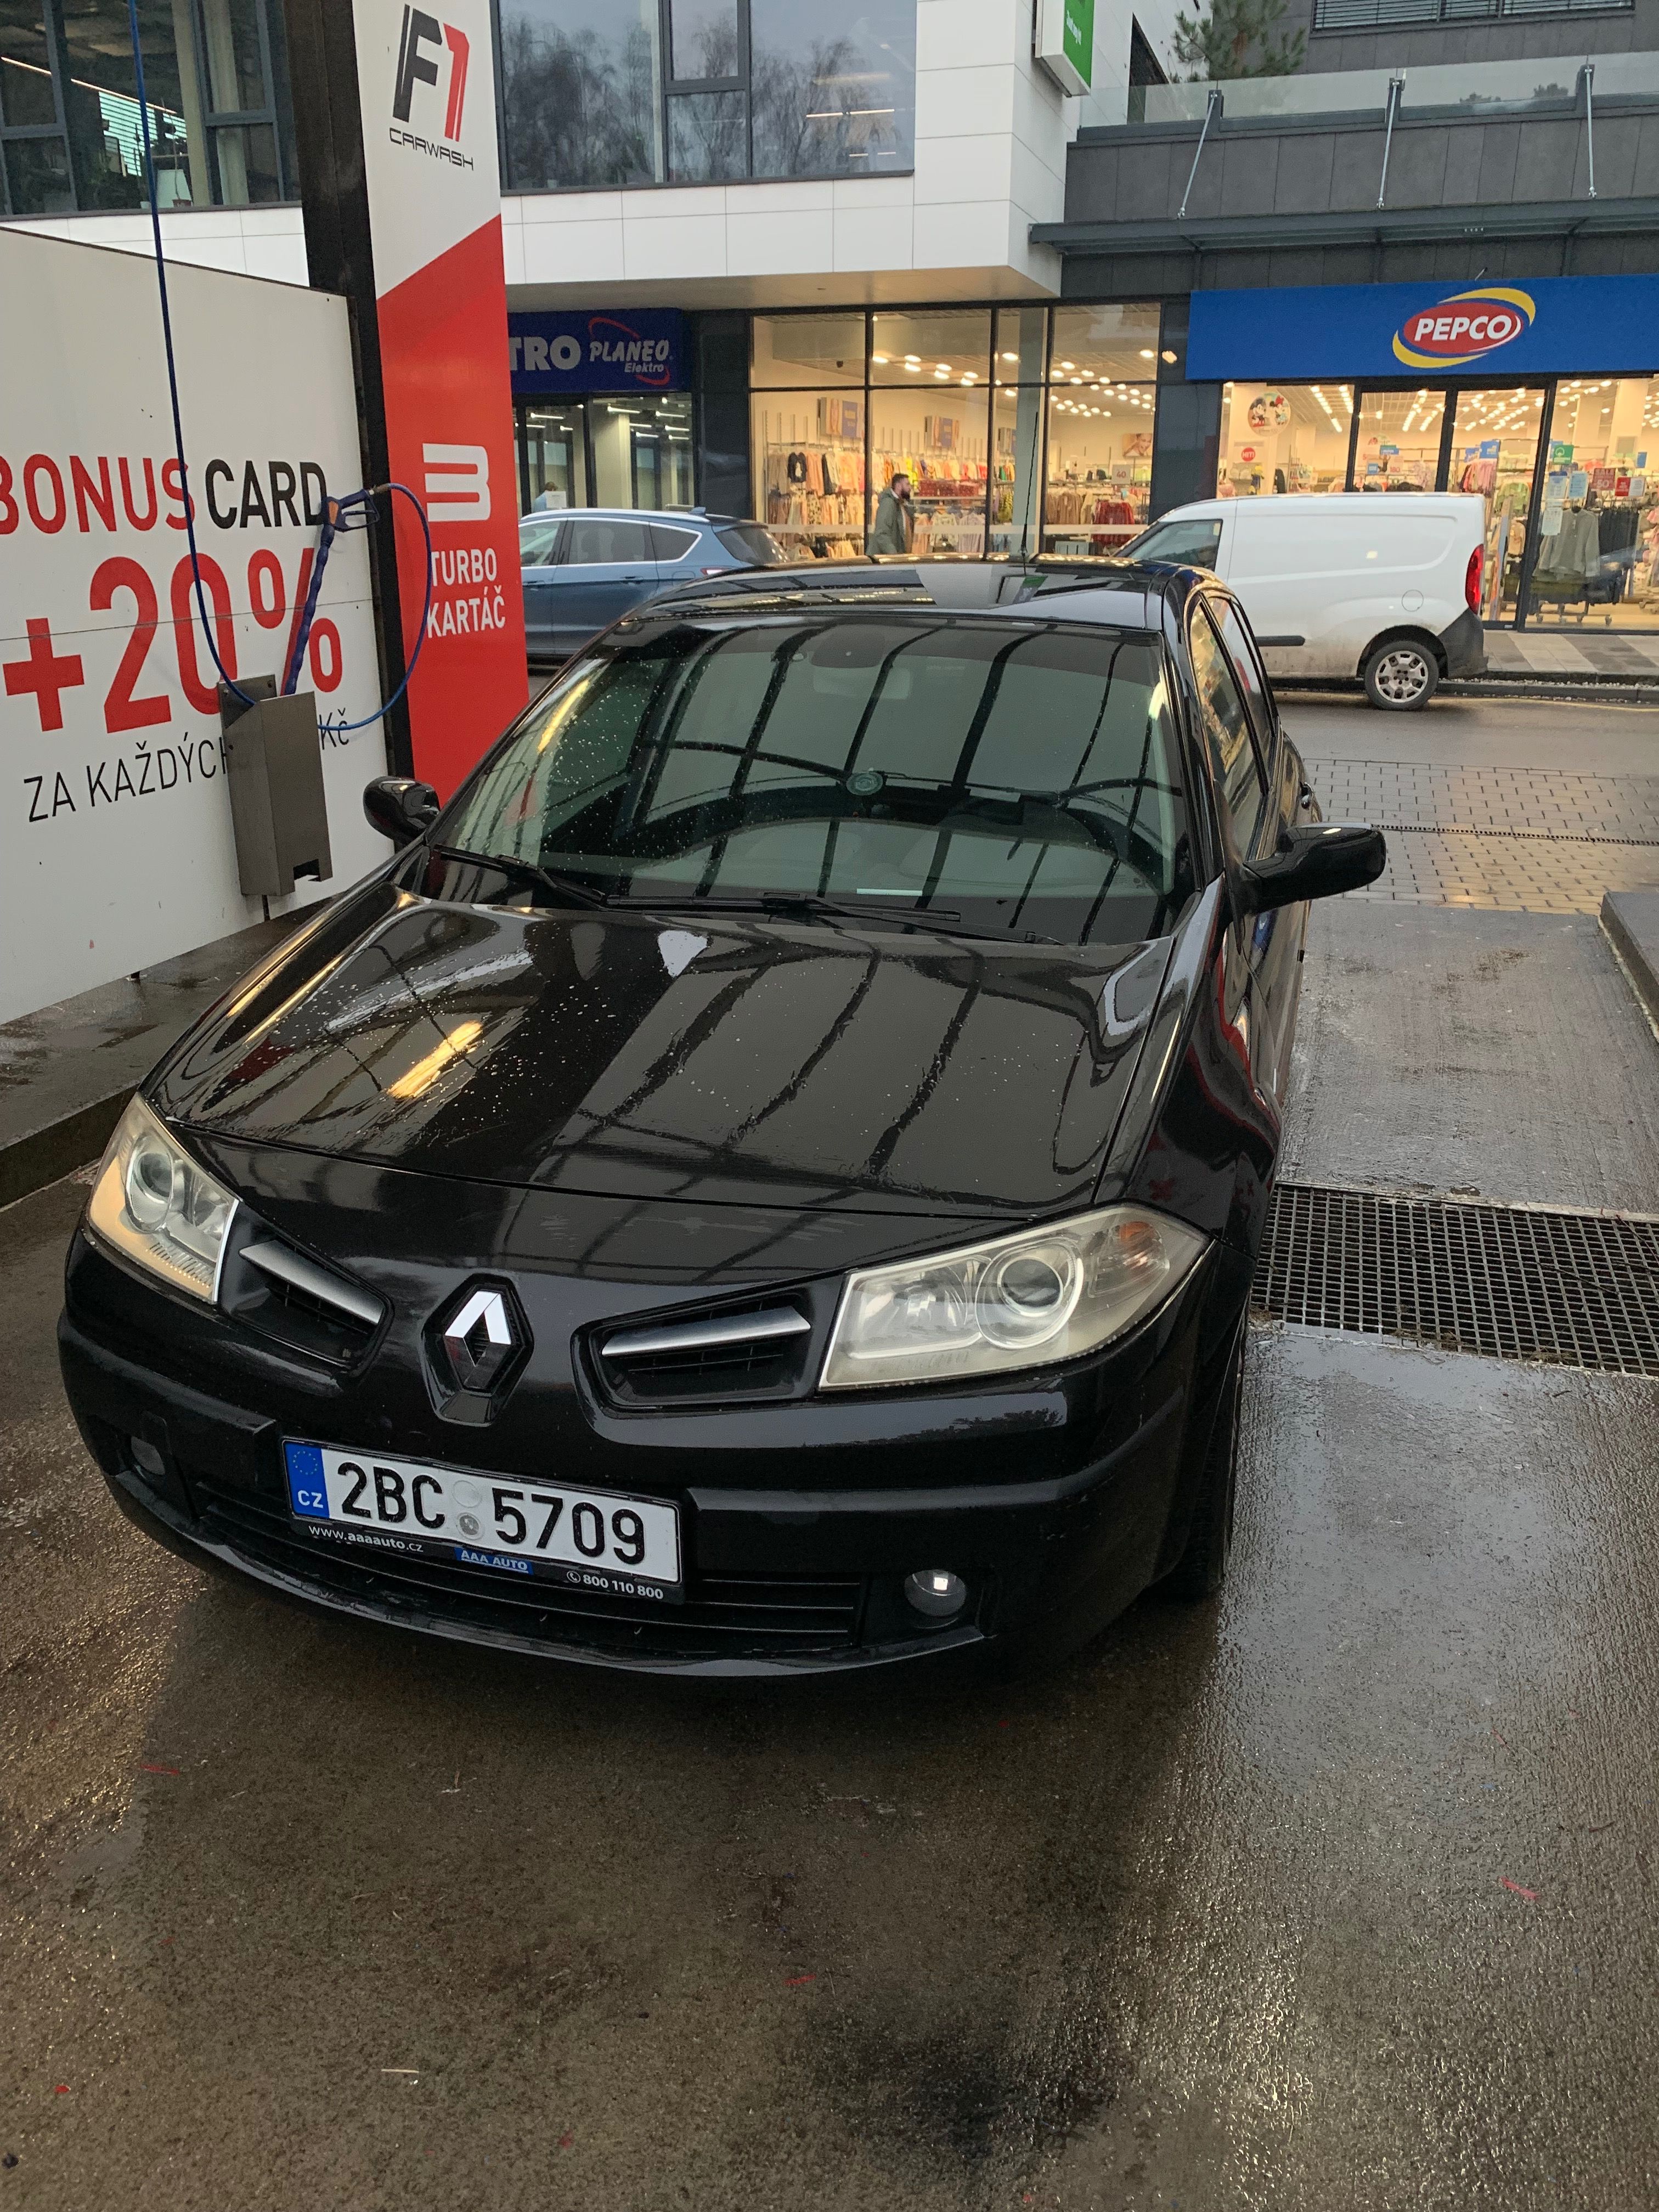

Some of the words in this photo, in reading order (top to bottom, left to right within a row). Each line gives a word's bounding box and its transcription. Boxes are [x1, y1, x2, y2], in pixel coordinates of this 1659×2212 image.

[392, 3, 470, 142] F1
[389, 127, 473, 171] CARWASH
[1414, 314, 1512, 342] PEPCO
[589, 339, 669, 363] PLANEO
[624, 363, 664, 373] Elektro
[205, 459, 329, 529] CARD
[431, 548, 497, 586] TURBO
[427, 585, 506, 639] KARTÁČ
[24, 771, 76, 822] ZA
[319, 707, 349, 750] Kč
[298, 1490, 324, 1509] CZ
[337, 1462, 445, 1529] 2BC
[492, 1486, 645, 1565] 5709
[308, 1525, 424, 1553] www.aaaauto.cz
[461, 1550, 489, 1564] AAA
[493, 1557, 528, 1571] AUTO
[583, 1574, 608, 1589] 800
[612, 1580, 634, 1594] 110
[637, 1585, 663, 1599] 800
